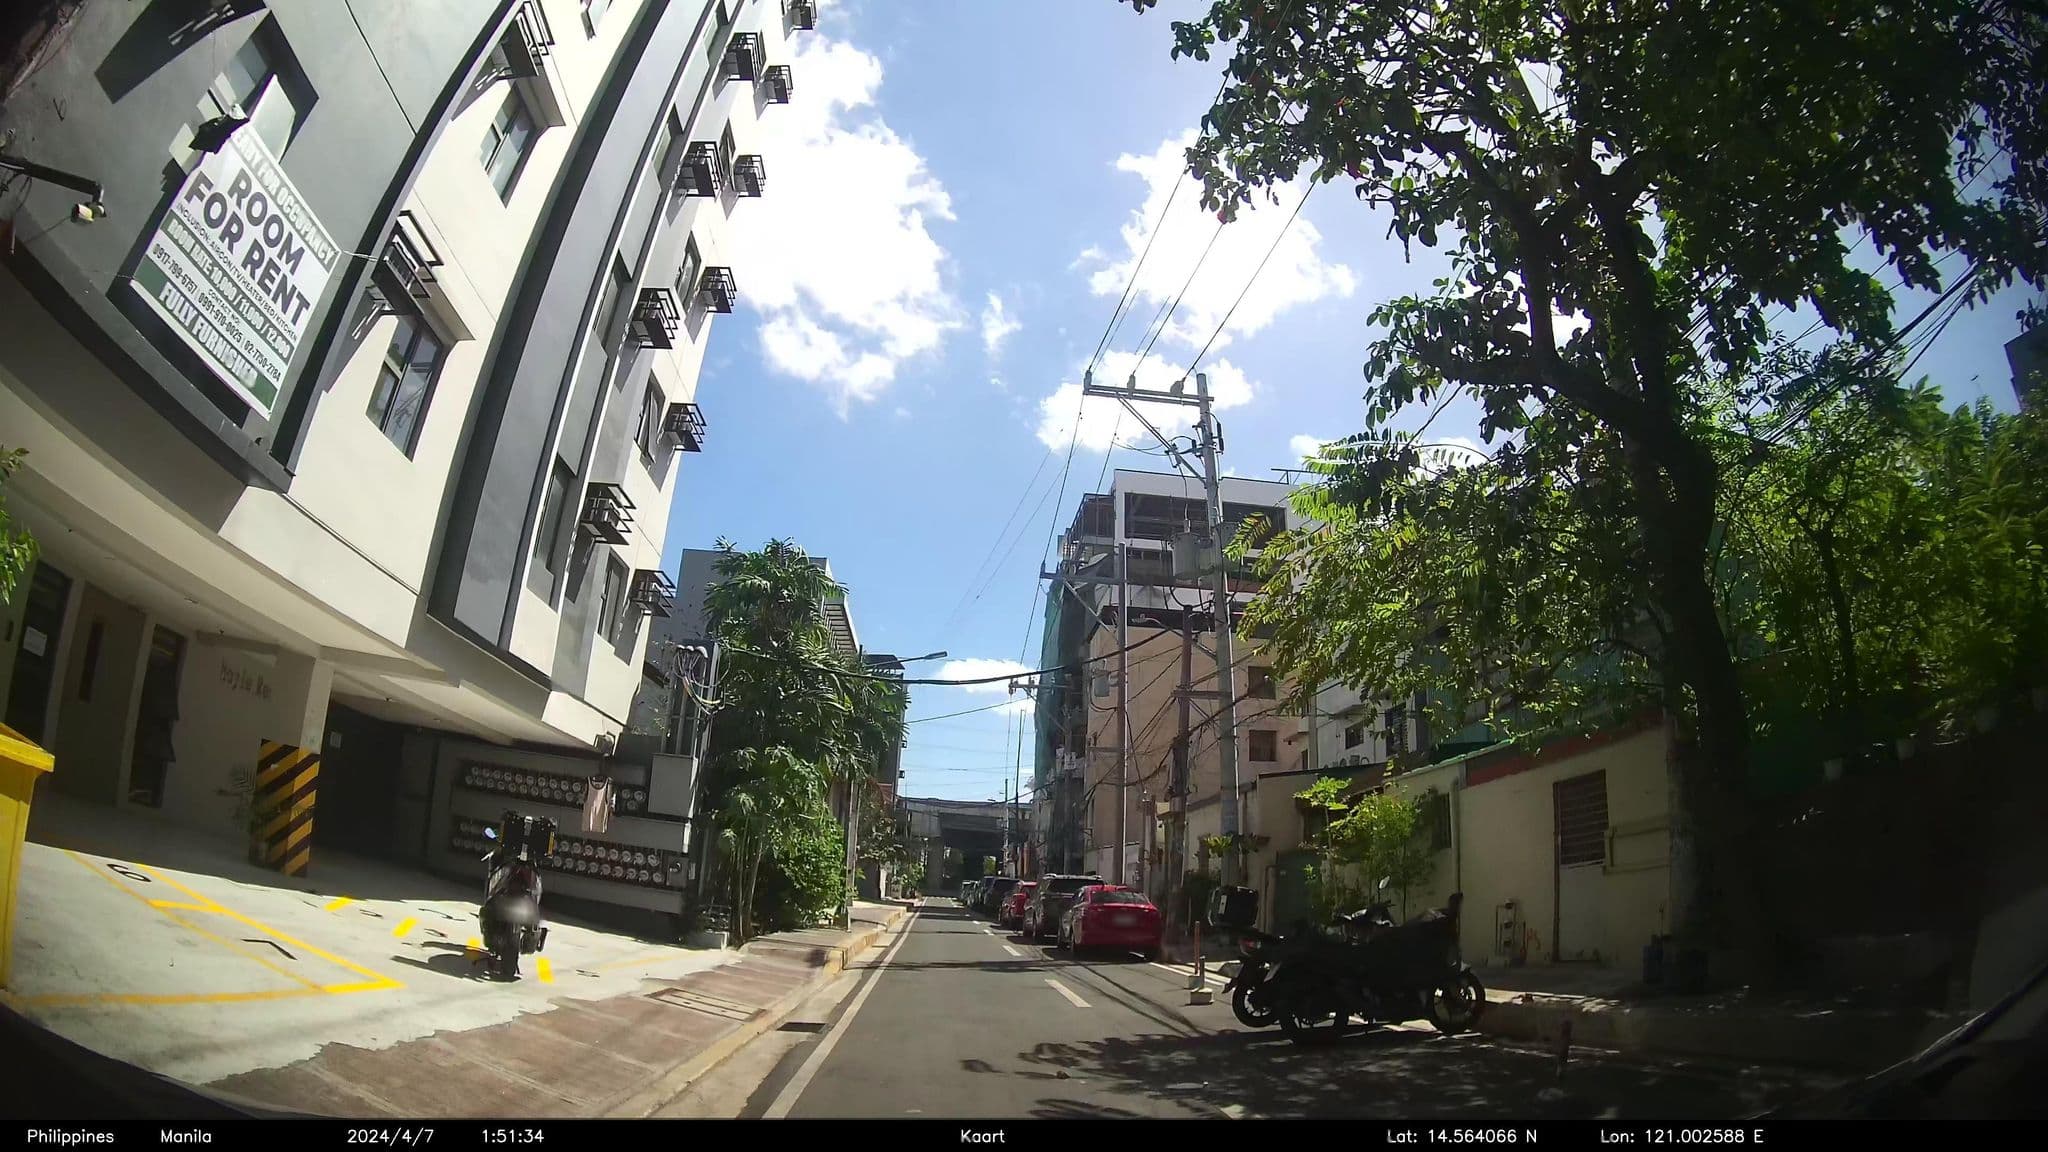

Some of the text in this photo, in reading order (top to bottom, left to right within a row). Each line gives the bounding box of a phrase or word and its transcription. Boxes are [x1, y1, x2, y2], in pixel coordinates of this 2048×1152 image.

[176, 203, 210, 242] INCLUSION:
[184, 170, 311, 326] FOR RENT
[228, 167, 305, 276] ROOM
[257, 161, 281, 196] FOR
[277, 186, 335, 265] OCCUPANCY
[159, 281, 198, 327] FULLY
[167, 219, 195, 253] ROOM
[190, 244, 213, 275] RATE:
[210, 267, 238, 301] 10,000
[239, 298, 264, 330] 11,000
[266, 327, 291, 359] 12,000
[208, 289, 231, 313] CONTACT
